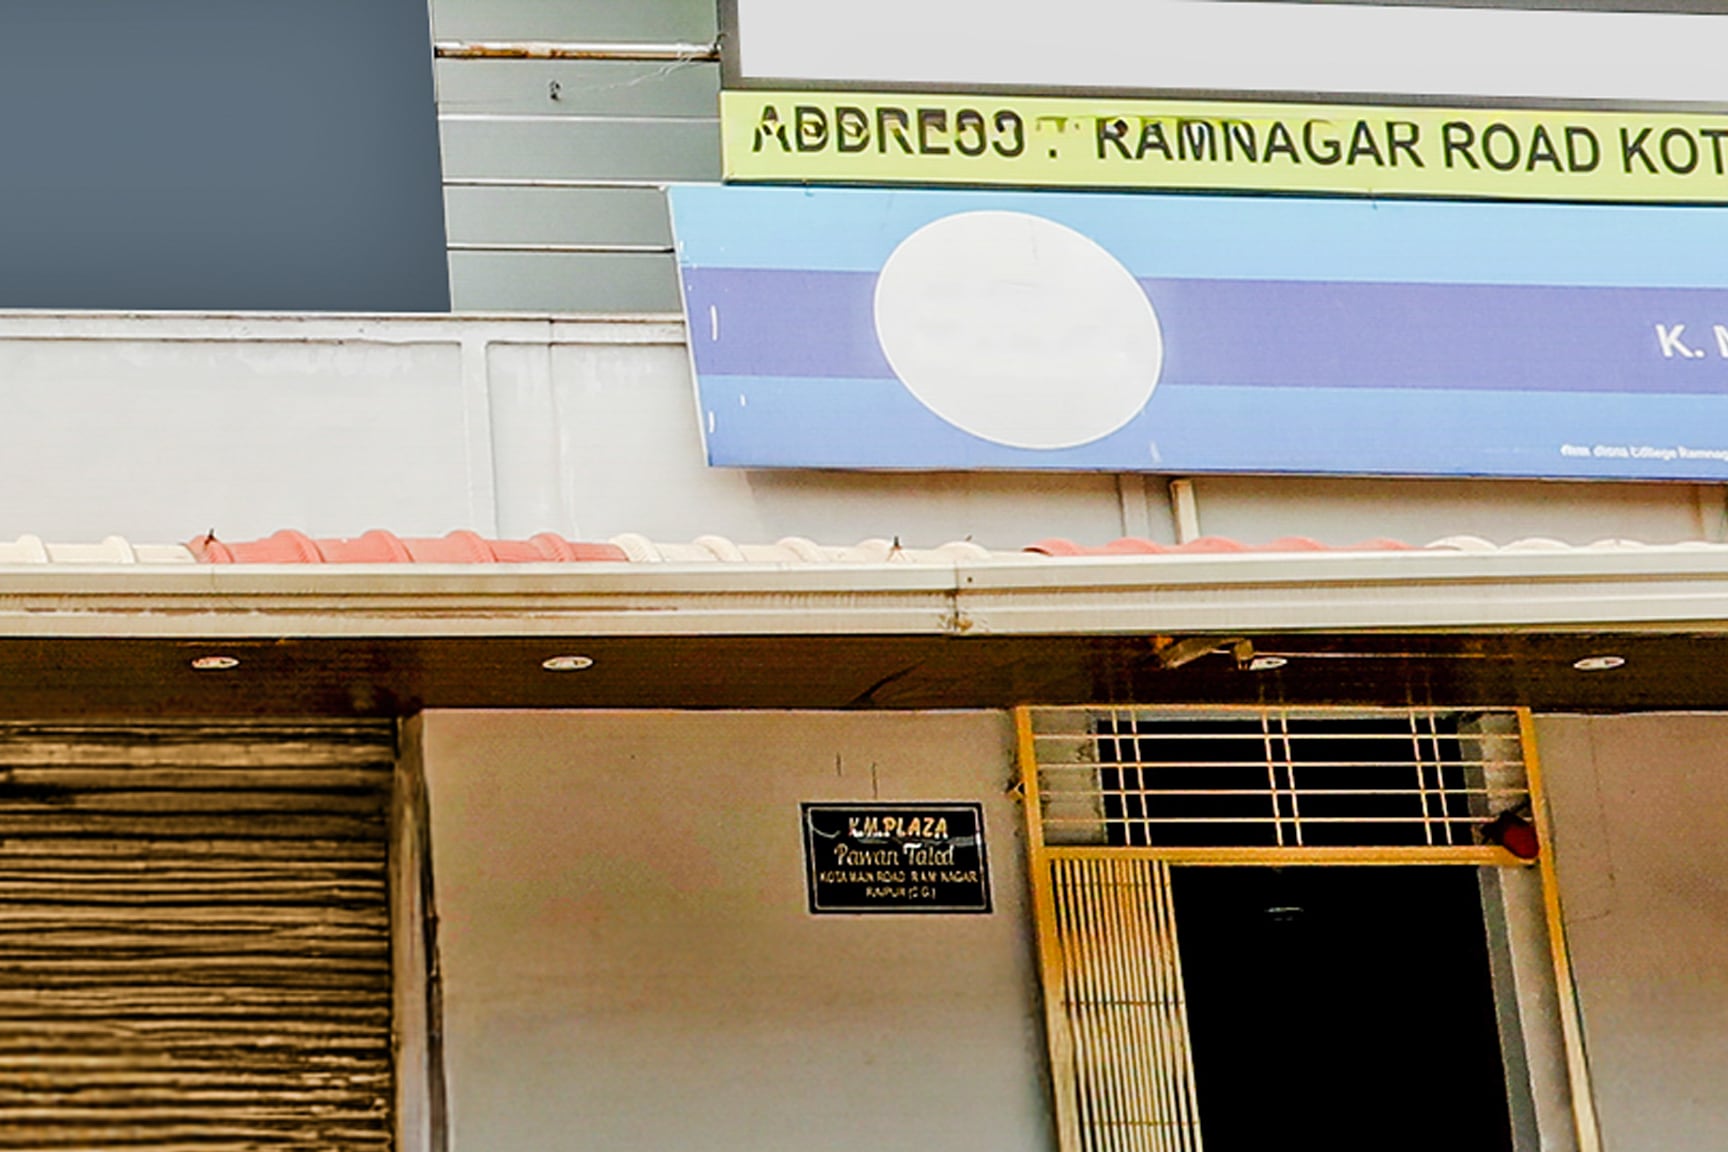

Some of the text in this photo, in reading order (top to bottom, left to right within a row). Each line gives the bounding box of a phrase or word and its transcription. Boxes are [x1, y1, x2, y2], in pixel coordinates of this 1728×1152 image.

[1094, 116, 1426, 168] RAMNAGAR
[1442, 121, 1601, 174] ROAD
[1655, 324, 1705, 358] K.
[834, 842, 899, 866] Pawan
